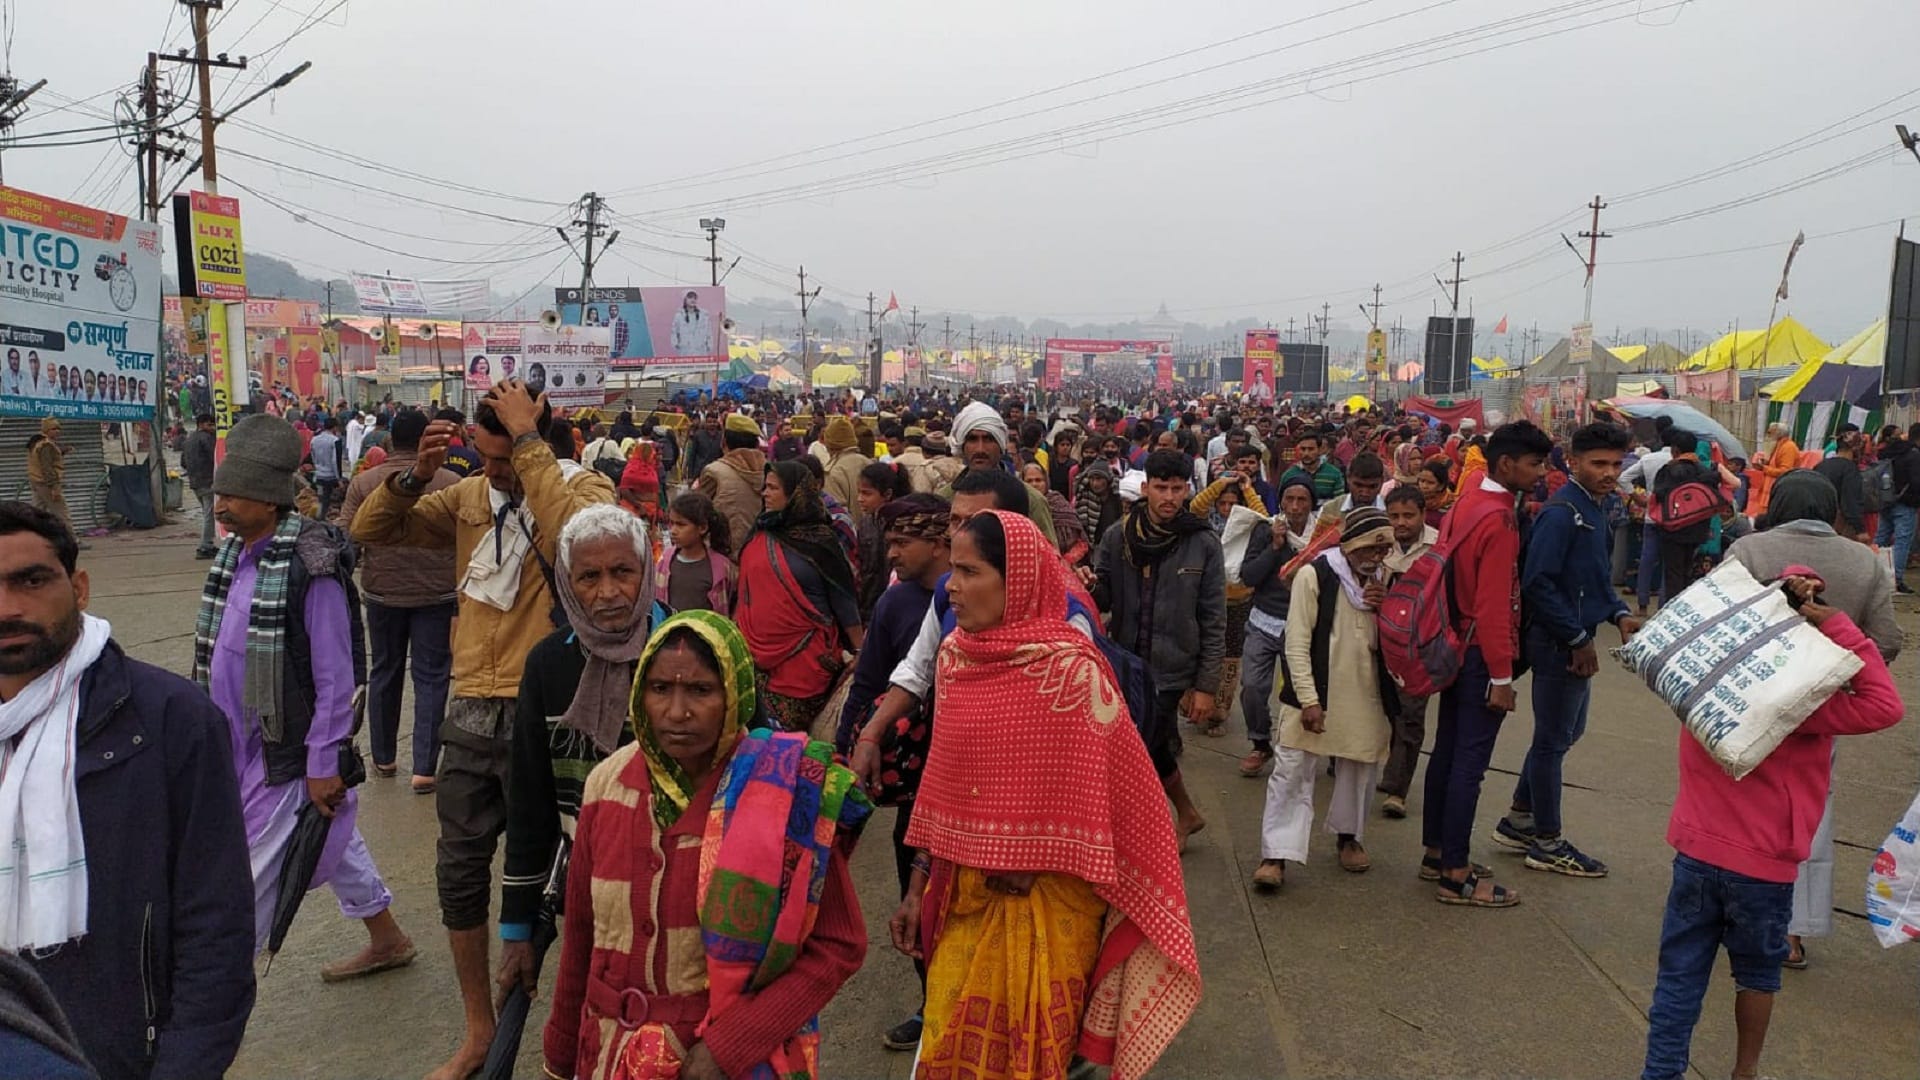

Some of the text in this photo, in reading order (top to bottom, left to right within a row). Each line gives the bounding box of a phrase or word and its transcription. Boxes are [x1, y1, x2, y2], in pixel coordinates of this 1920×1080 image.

[200, 242, 240, 265] cozi
[0, 261, 80, 291] ICITY
[0, 282, 65, 303] eciality Hospital
[115, 350, 155, 371] इलाज
